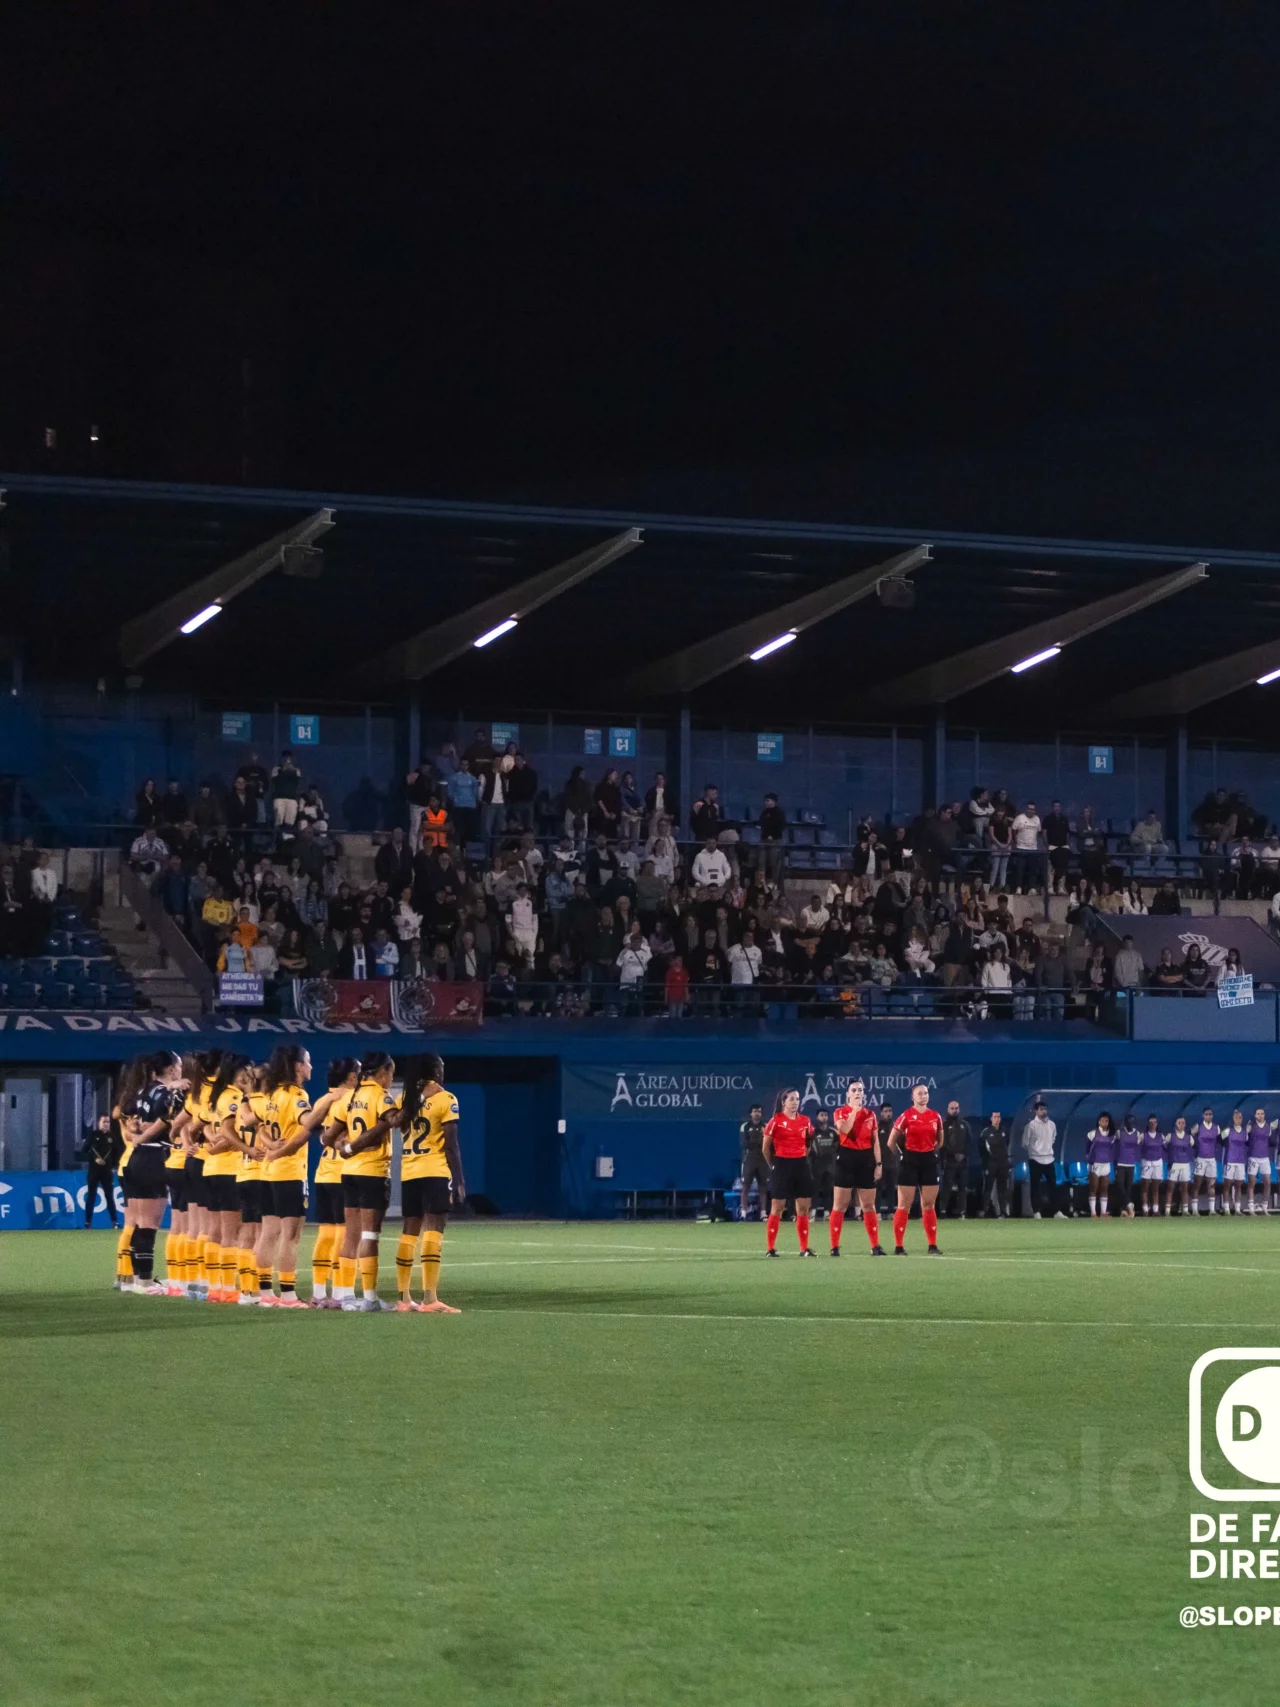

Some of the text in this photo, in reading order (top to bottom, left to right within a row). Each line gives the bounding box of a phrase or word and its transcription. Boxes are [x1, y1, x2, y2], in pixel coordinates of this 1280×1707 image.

[297, 726, 312, 739] D-1
[616, 738, 629, 751] C-1
[0, 1015, 53, 1031] A
[61, 1015, 201, 1033] DANI
[215, 1017, 426, 1034] JARQUE
[680, 1073, 754, 1092] JURÍDICA
[635, 1093, 703, 1107] GLOBAL
[824, 1093, 886, 1107] GLBAL
